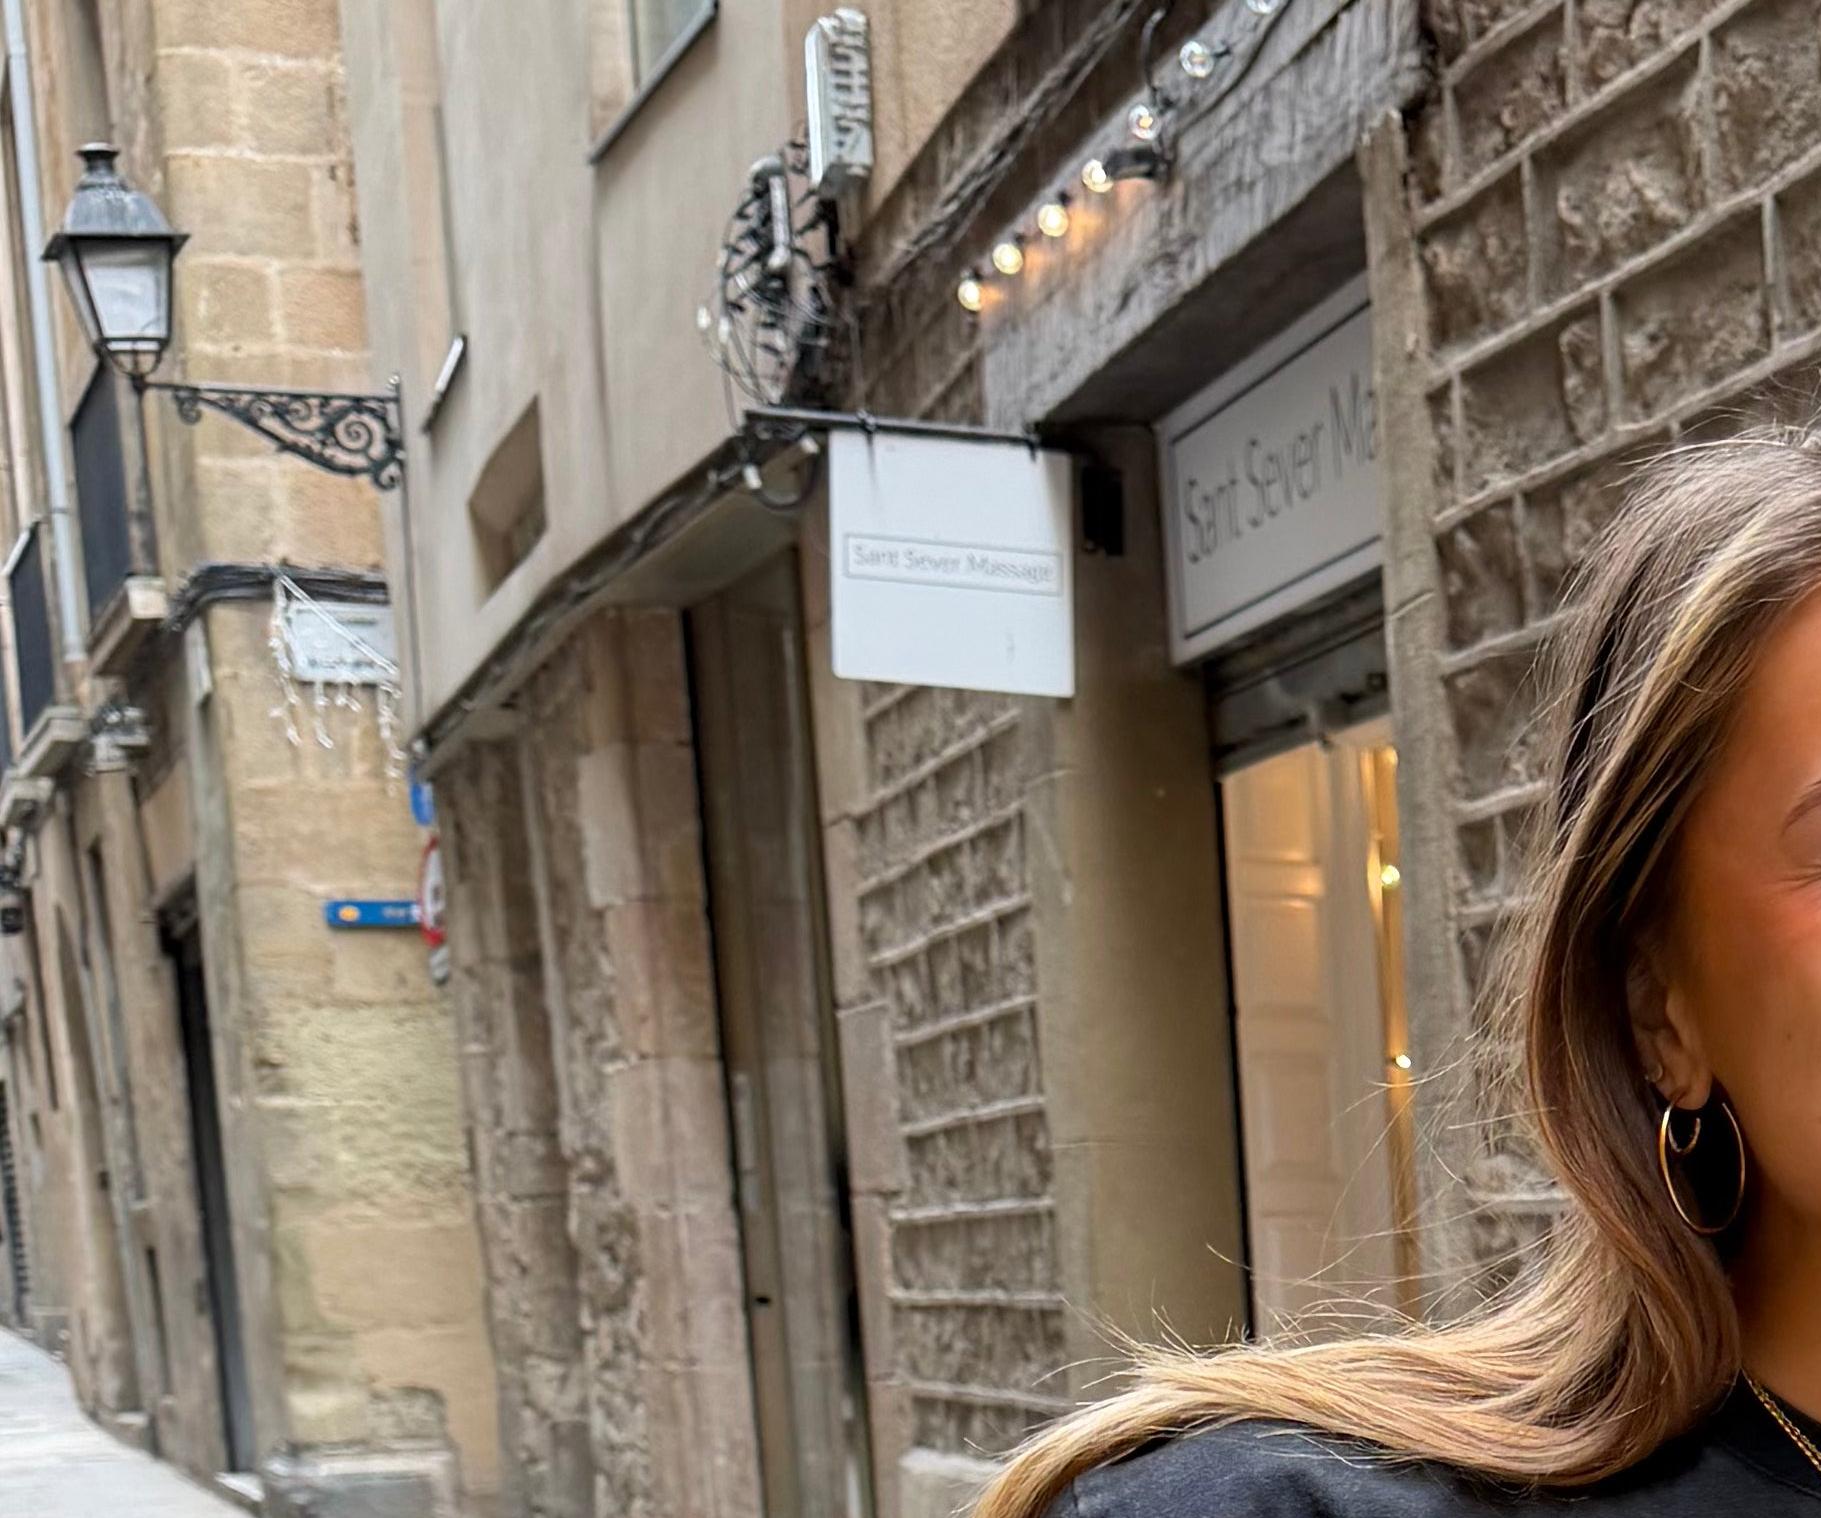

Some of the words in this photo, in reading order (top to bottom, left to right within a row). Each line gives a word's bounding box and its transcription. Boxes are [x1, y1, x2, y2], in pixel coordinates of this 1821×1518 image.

[1183, 456, 1243, 564] Sant
[1244, 420, 1325, 528] Sever
[965, 552, 1054, 585] Massage
